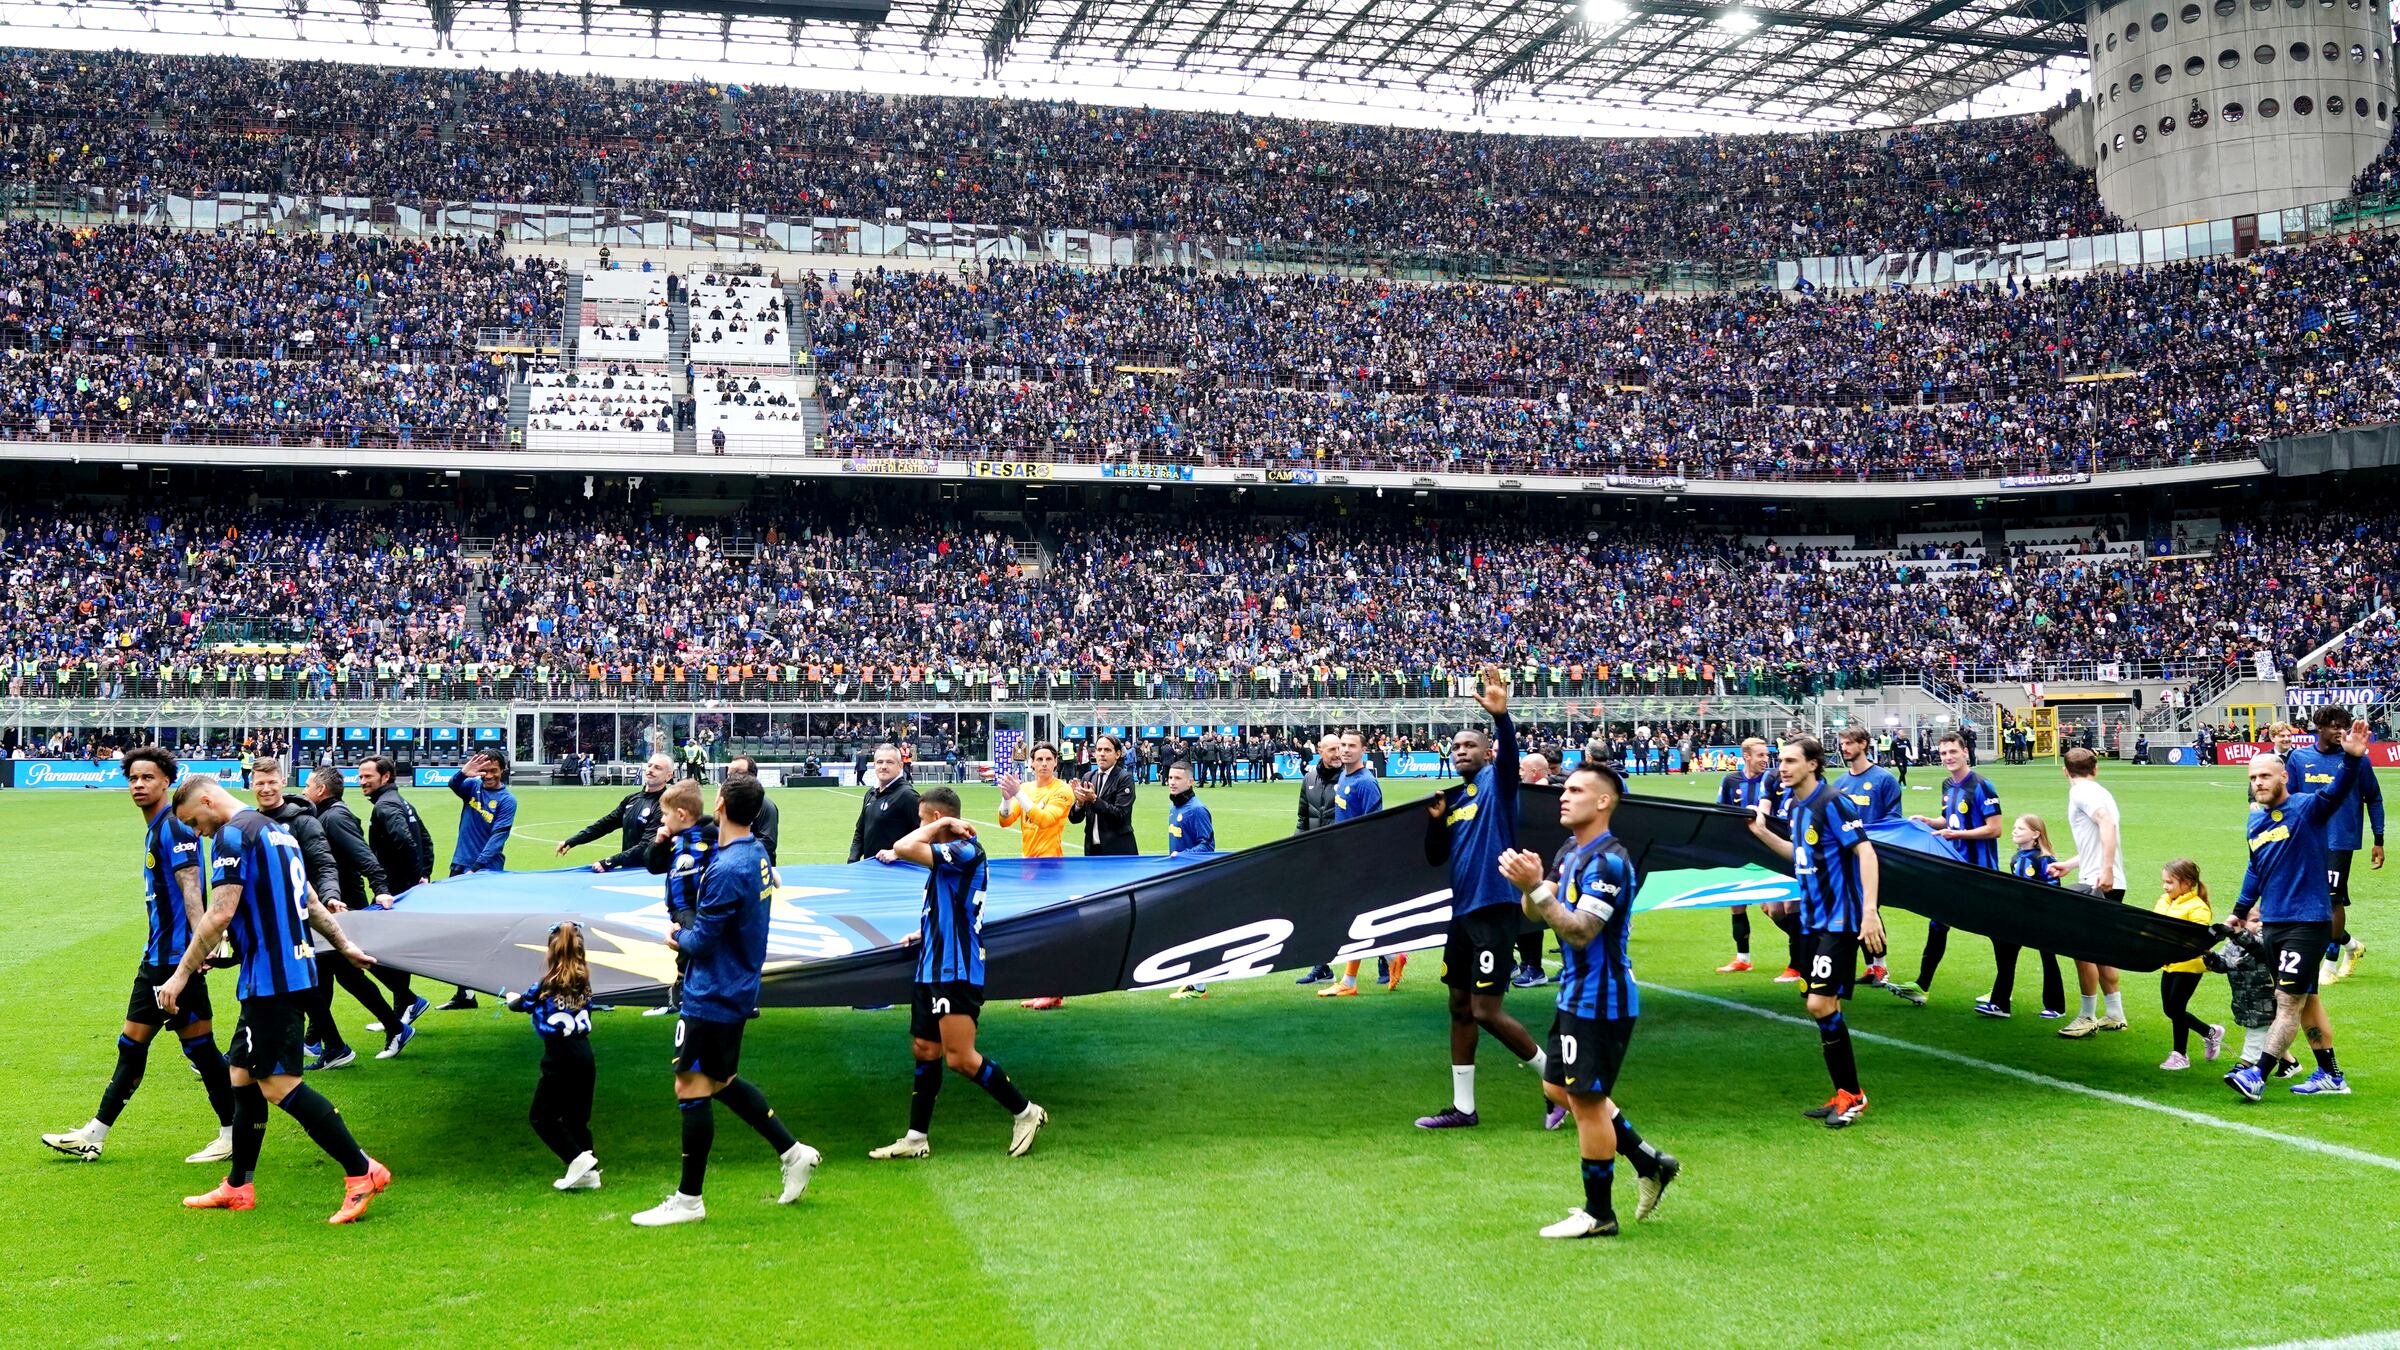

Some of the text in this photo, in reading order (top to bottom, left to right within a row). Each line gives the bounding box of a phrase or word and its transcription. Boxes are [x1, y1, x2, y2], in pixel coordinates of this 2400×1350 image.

[856, 463, 887, 472] GROTTE
[888, 464, 896, 472] DI
[897, 464, 929, 473] CASTRO
[1115, 469, 1180, 479] NERAZZURRA
[2018, 474, 2071, 485] BELLUSCO
[25, 763, 120, 785] Paramount+
[173, 841, 198, 853] ebay
[212, 856, 242, 869] ebay
[1590, 879, 1622, 897] ebay
[1479, 950, 1495, 974] 9
[1560, 1034, 1578, 1065] 10
